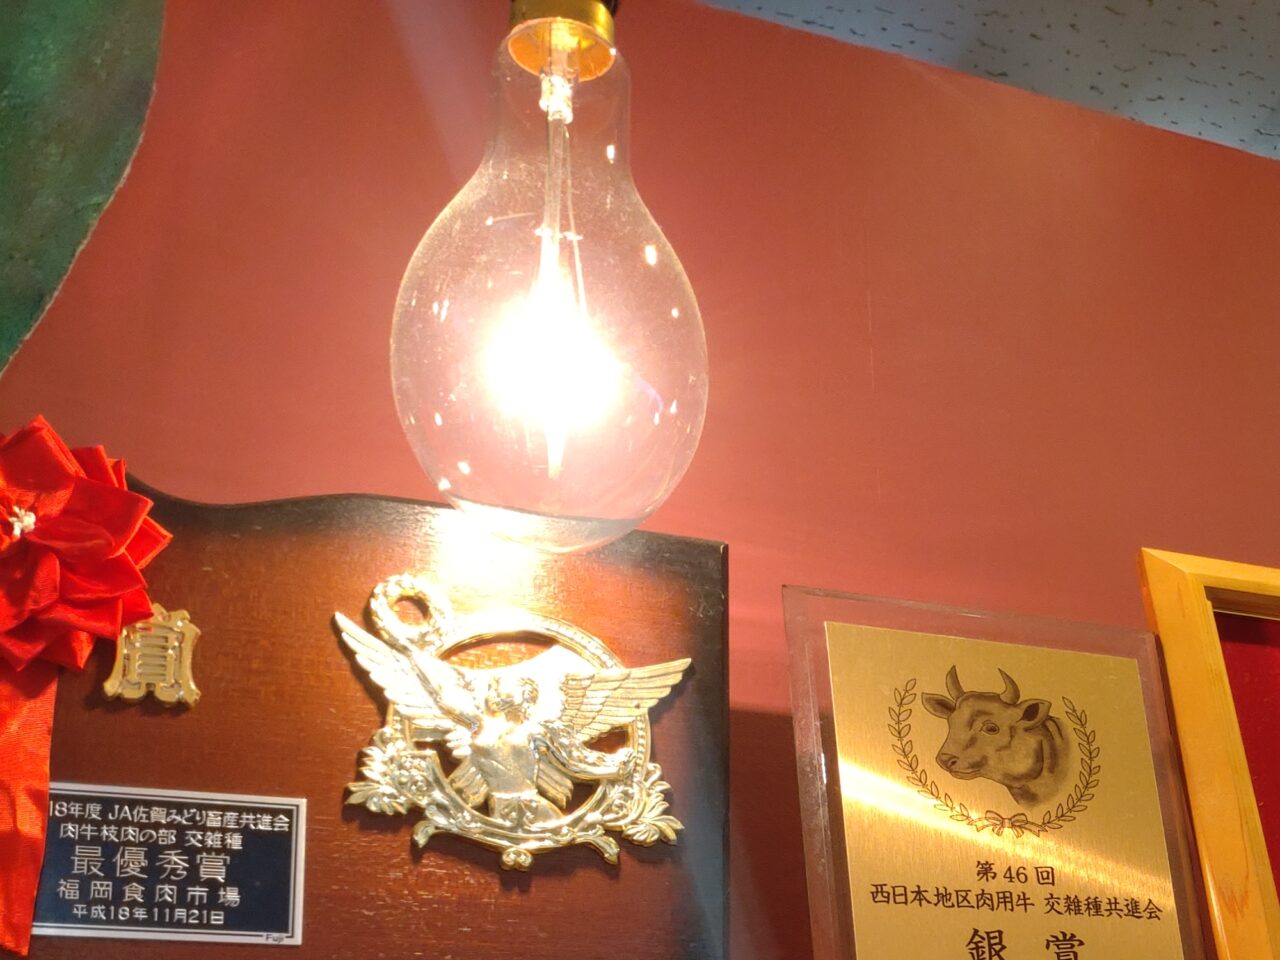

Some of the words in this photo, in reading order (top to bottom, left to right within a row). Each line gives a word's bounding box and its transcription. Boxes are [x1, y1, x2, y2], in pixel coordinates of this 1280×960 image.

[108, 803, 291, 832] JA佐賀みどり畜産共進会
[59, 823, 176, 844] 肉牛枝肉の部
[184, 830, 244, 850] 交雑種
[70, 845, 231, 883] 最優秀賞
[975, 860, 1056, 887] 第46回
[56, 878, 241, 908] 福岡食肉市場
[870, 883, 1036, 913] 西日本地区肉用牛
[1043, 893, 1164, 921] 交雑種共進会
[72, 903, 225, 925] 平成18年11月21日
